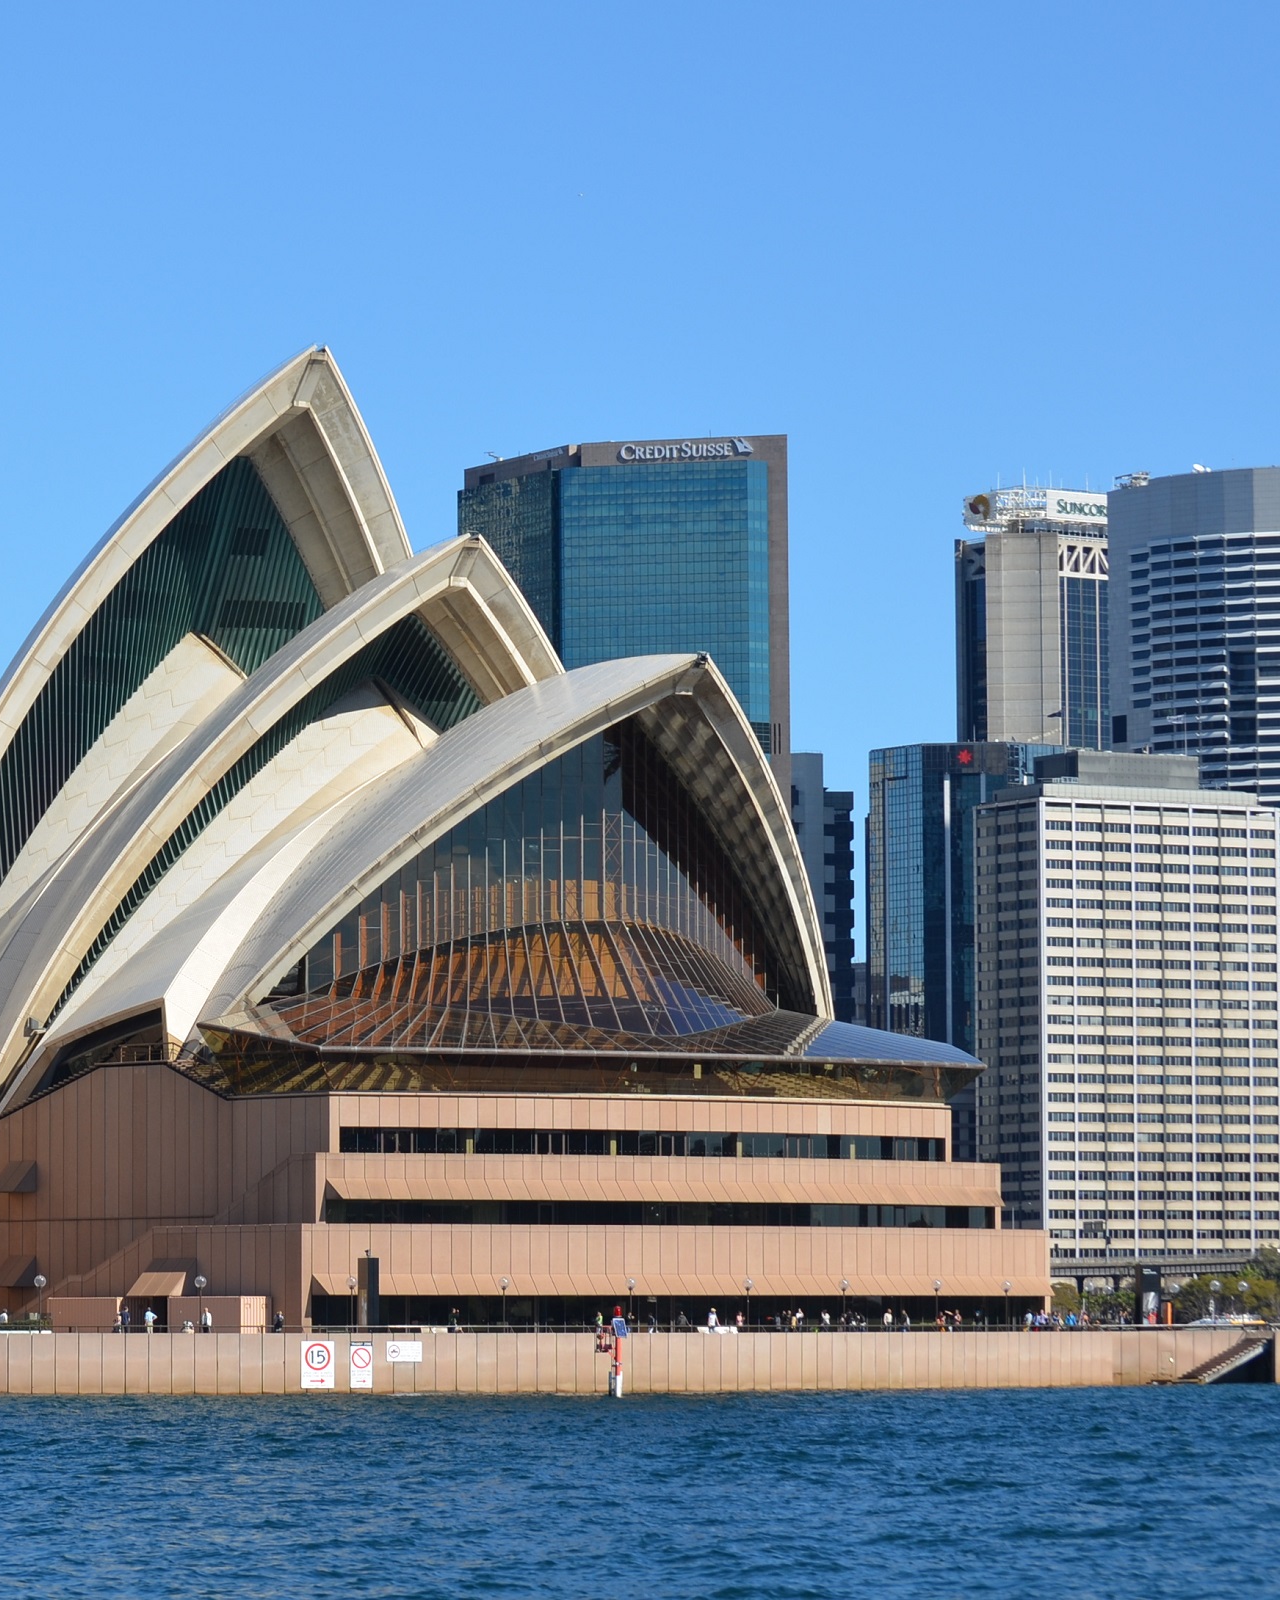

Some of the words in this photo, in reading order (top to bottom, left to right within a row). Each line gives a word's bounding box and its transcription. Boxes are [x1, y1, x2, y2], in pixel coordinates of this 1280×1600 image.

[620, 444, 680, 460] CREDIT
[681, 442, 733, 458] SUISSE
[1056, 498, 1108, 517] SUNCOR
[311, 1350, 326, 1364] 15
